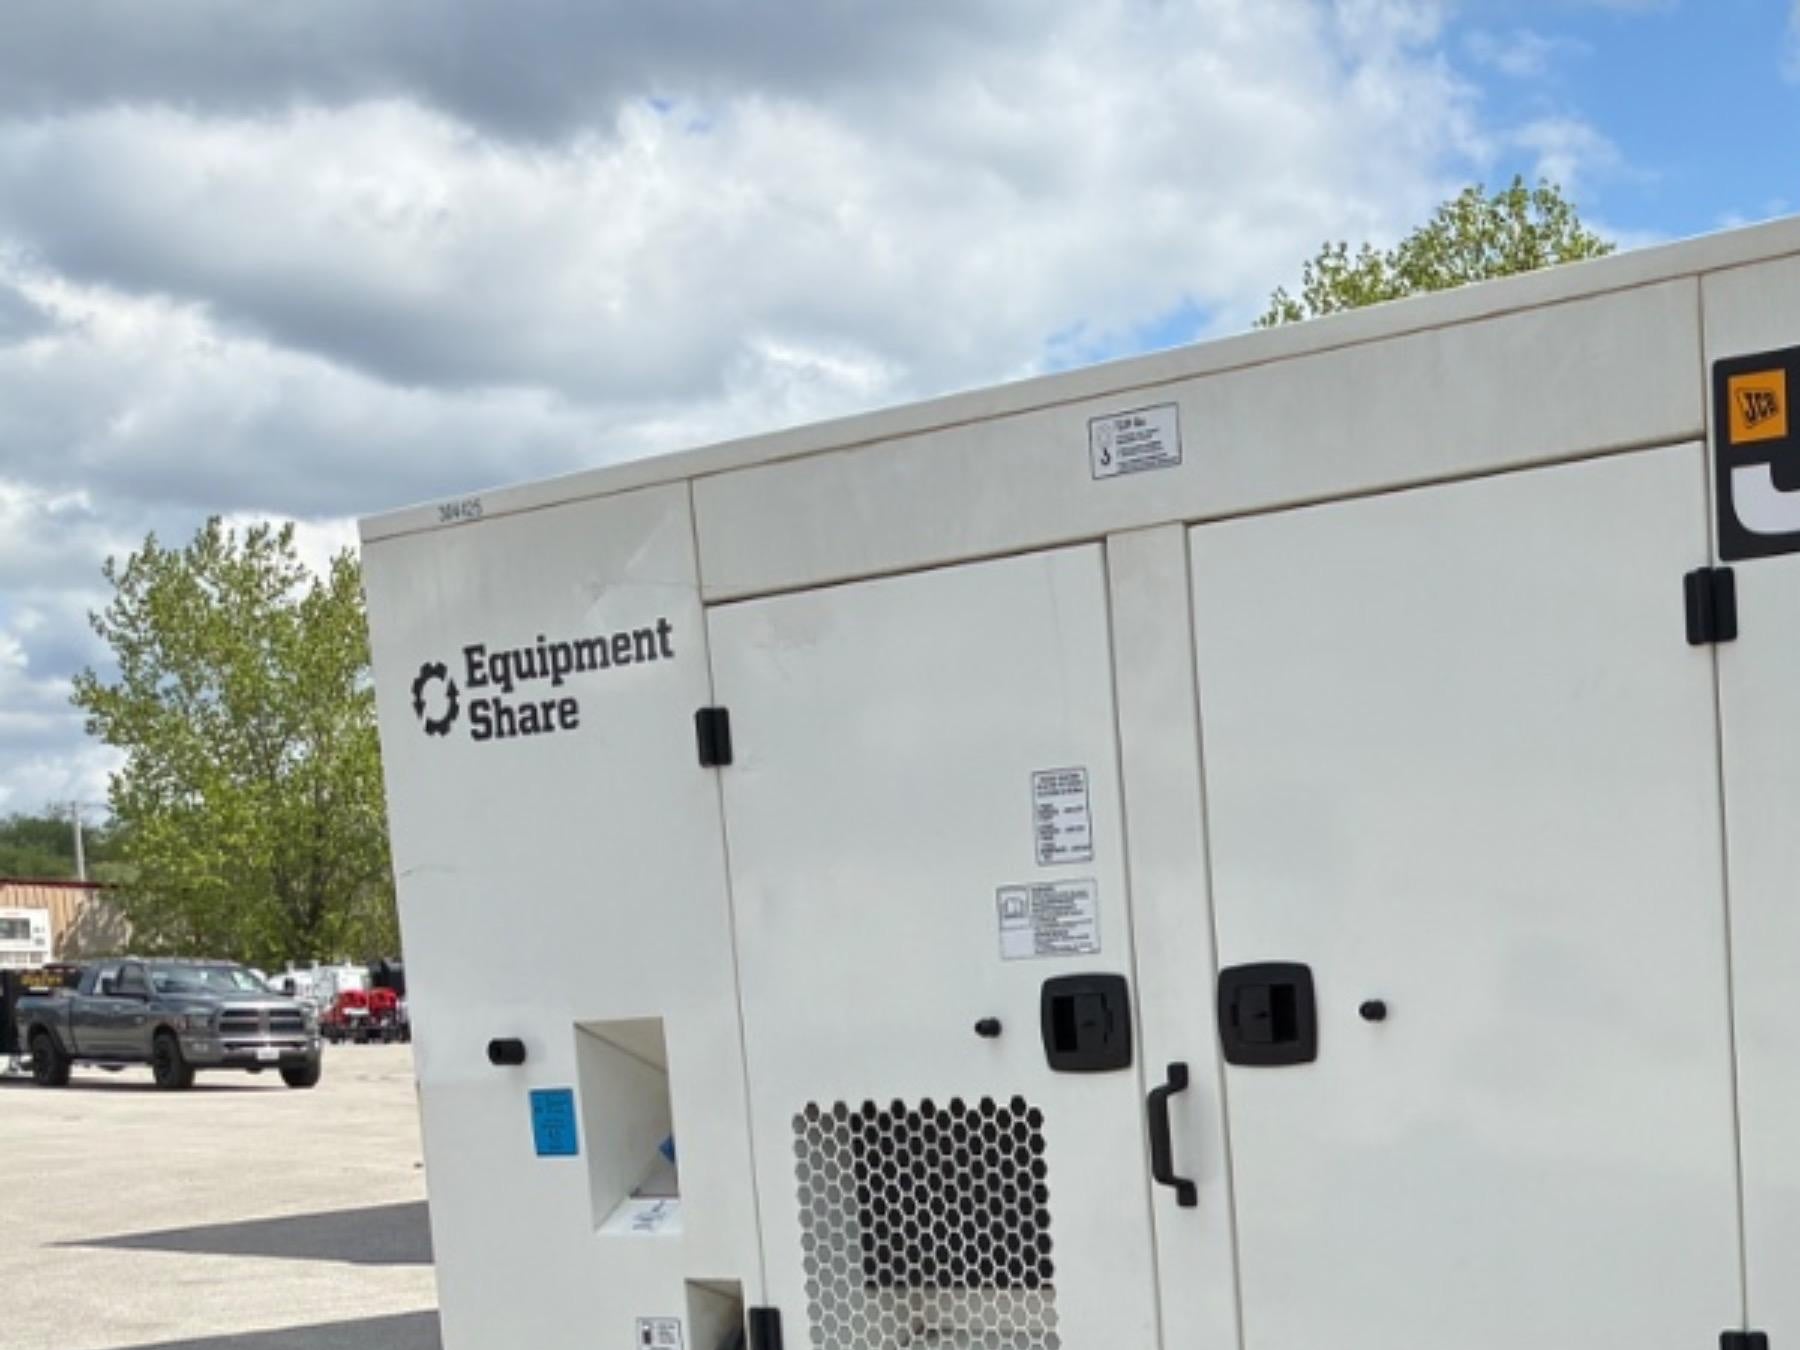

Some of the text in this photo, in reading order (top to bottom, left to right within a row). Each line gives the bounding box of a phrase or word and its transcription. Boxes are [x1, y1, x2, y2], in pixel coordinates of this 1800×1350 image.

[1742, 391, 1778, 424] JCB
[464, 618, 673, 694] Equipment
[468, 692, 579, 741] Share
